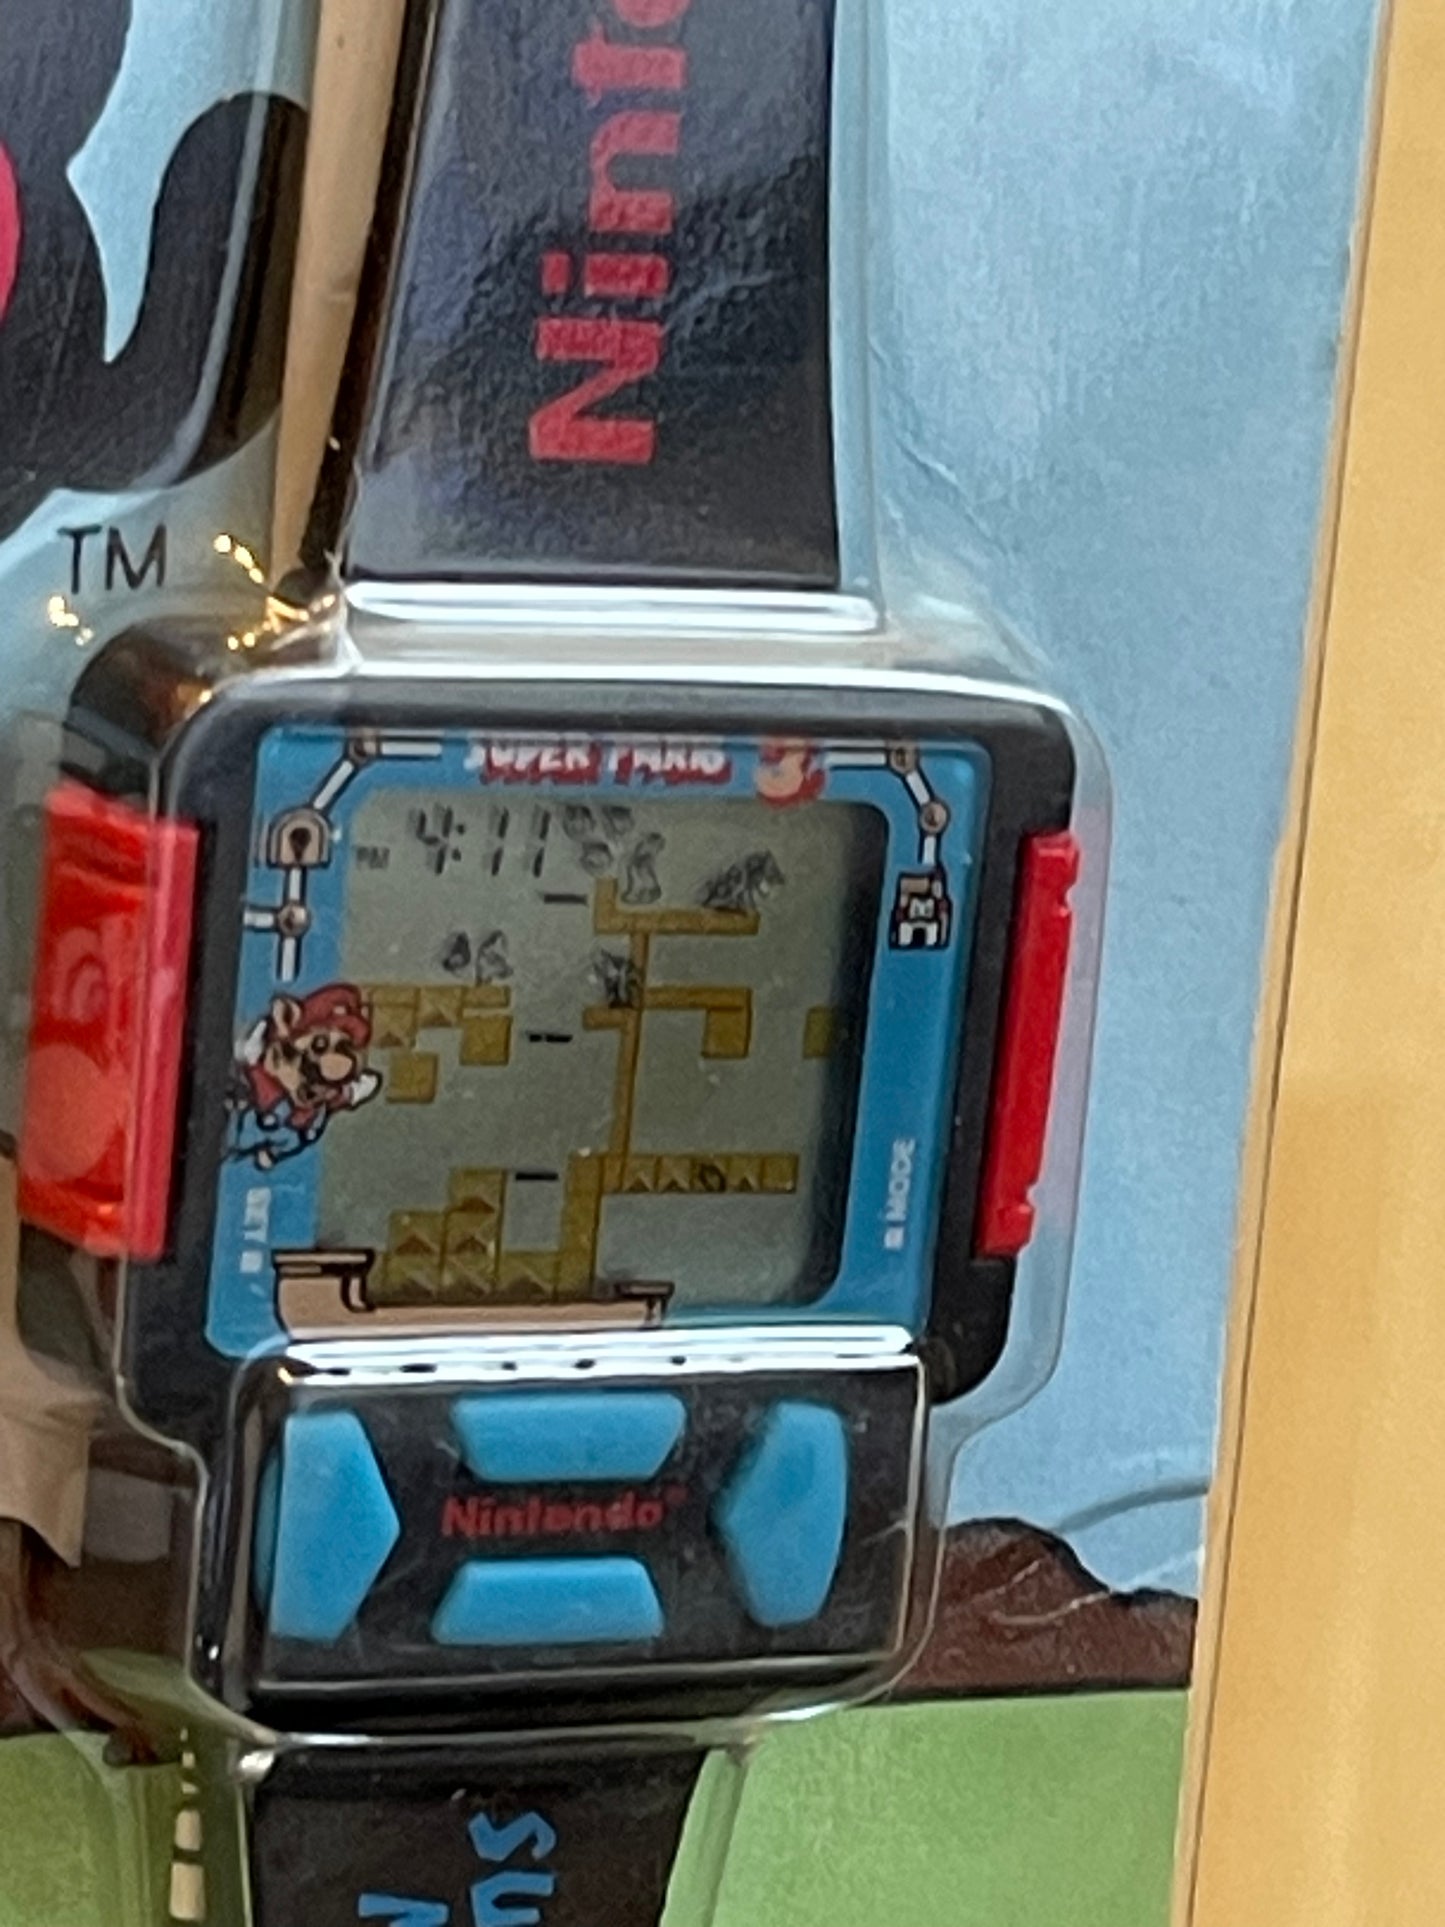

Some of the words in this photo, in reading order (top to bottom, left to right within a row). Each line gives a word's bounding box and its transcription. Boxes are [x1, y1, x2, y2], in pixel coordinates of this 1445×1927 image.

[57, 524, 167, 594] TM
[464, 737, 602, 785] SUPER
[755, 736, 826, 807] 3
[411, 804, 553, 877] 4:11
[885, 1138, 917, 1222] MODE
